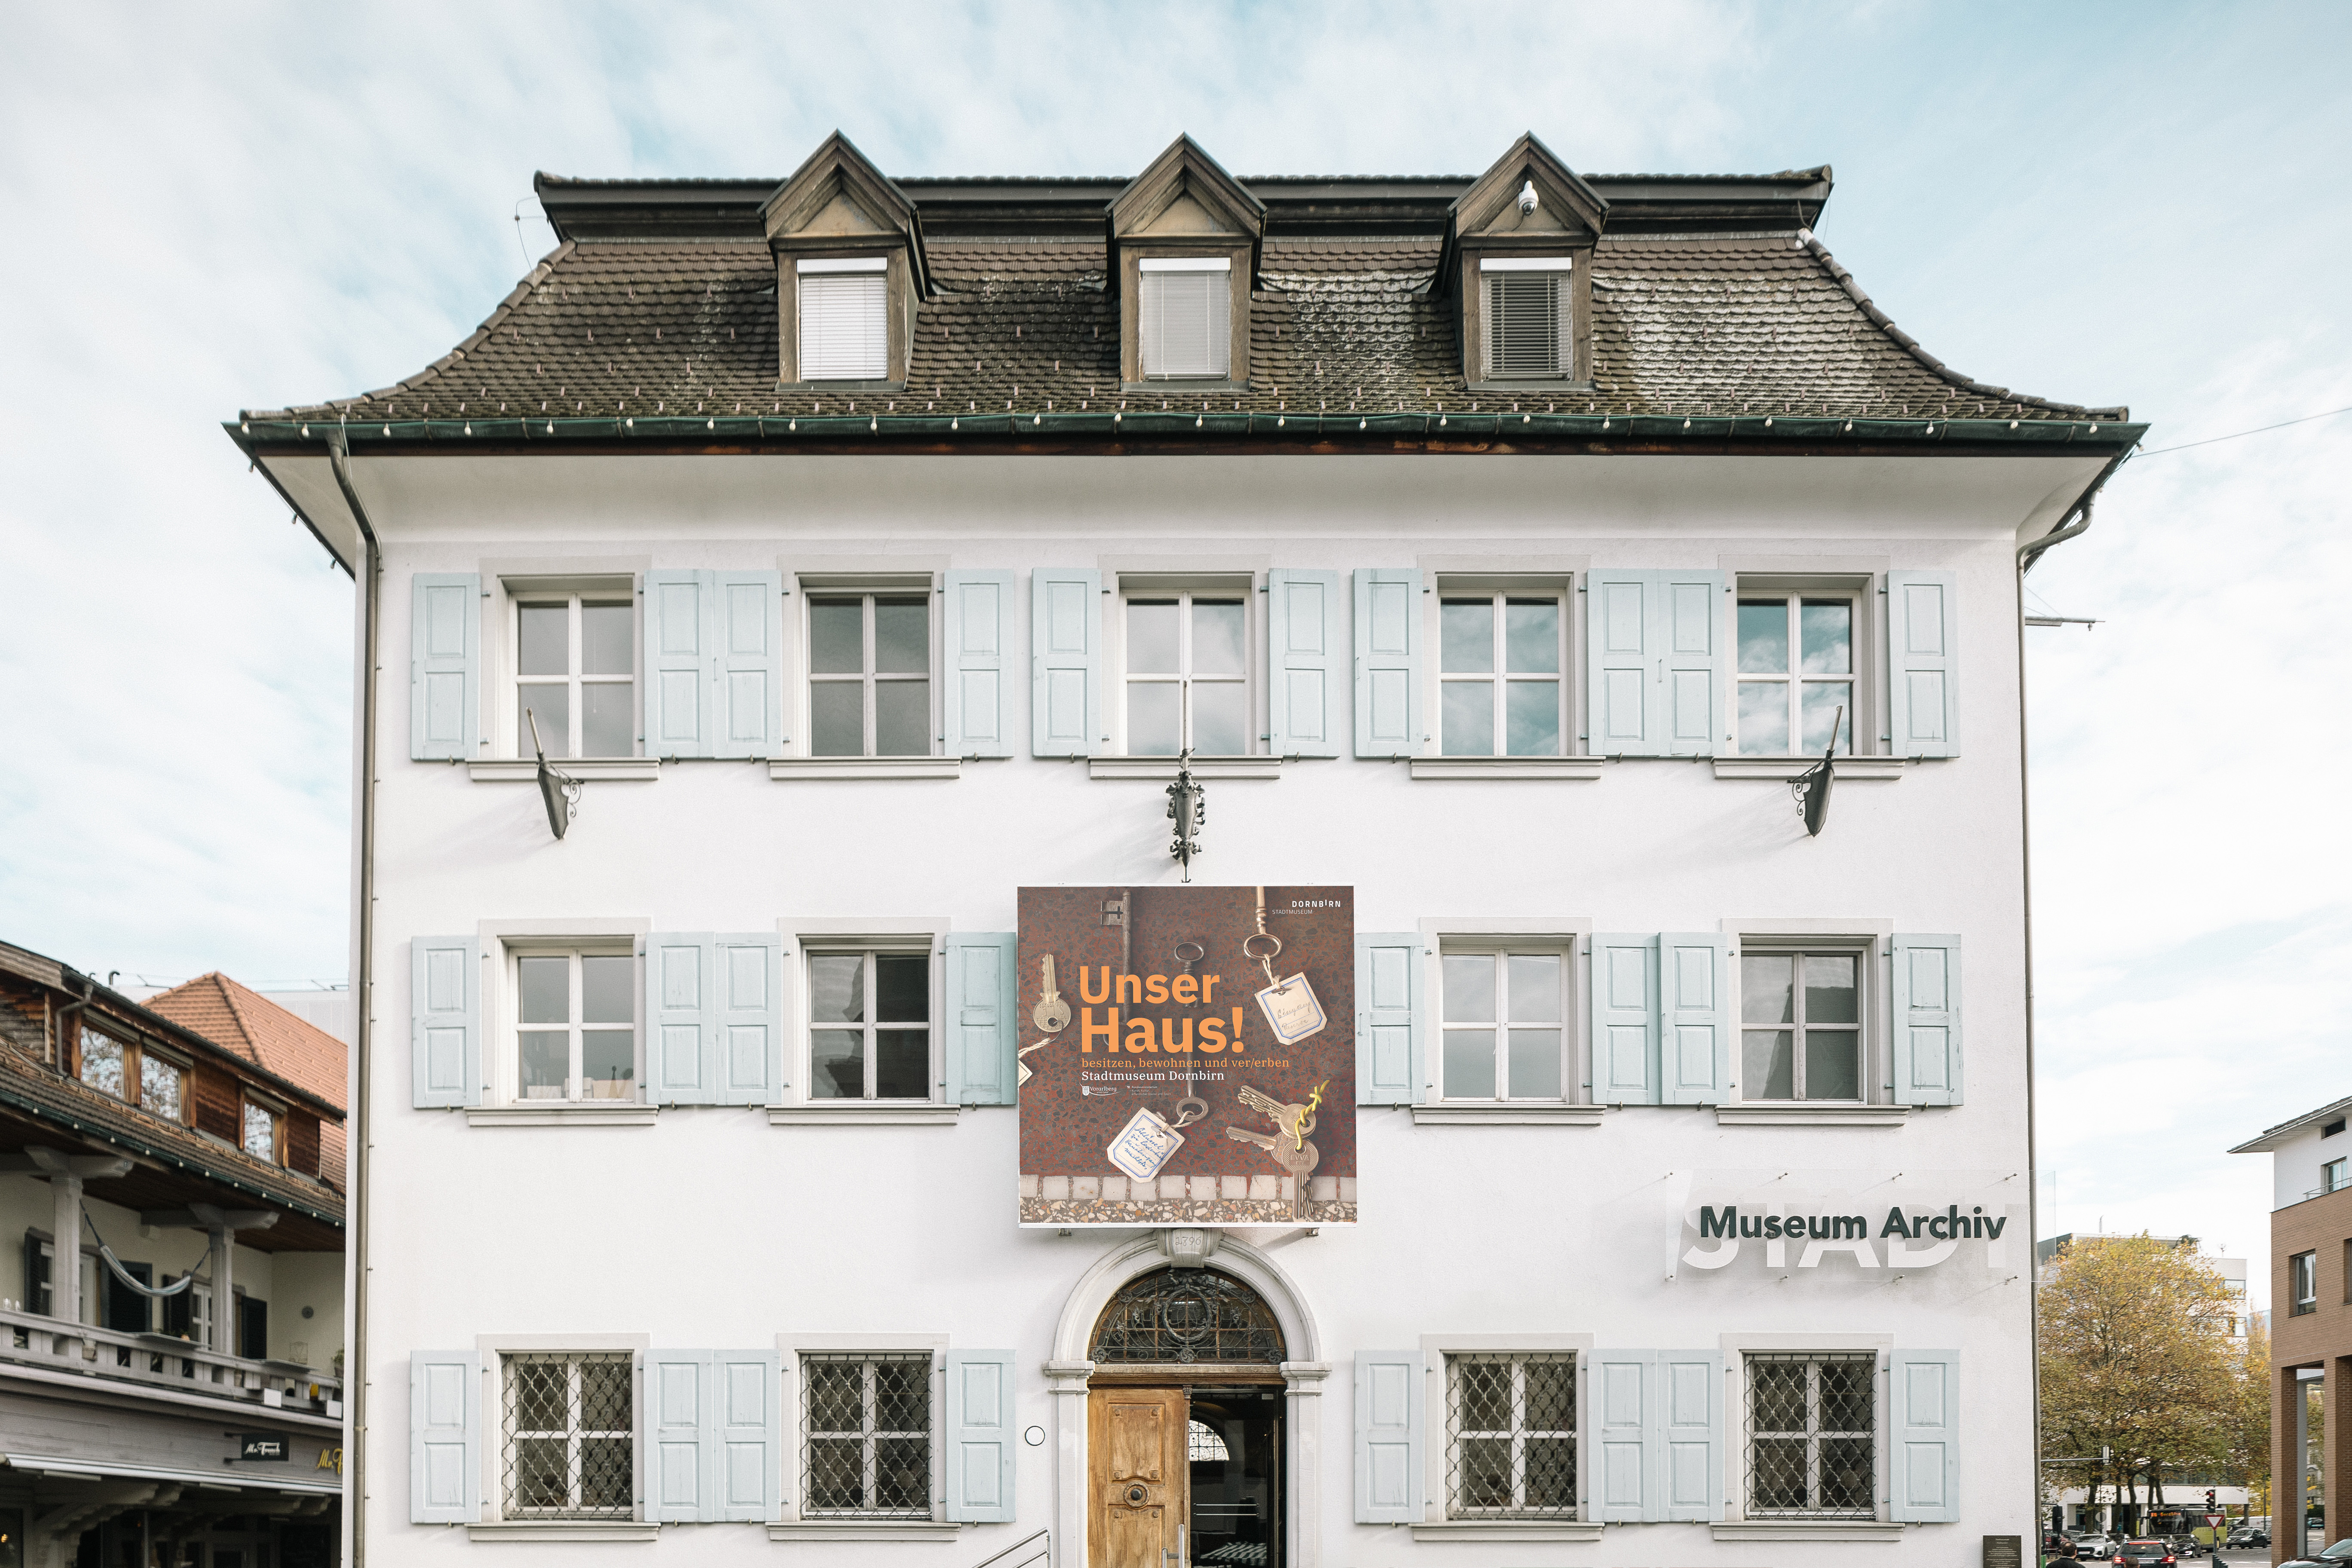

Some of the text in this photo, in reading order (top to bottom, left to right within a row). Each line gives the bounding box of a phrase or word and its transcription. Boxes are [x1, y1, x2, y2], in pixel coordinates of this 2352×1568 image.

[1292, 899, 1341, 907] DORNBIRN
[1080, 966, 1220, 1004] Unser
[1081, 1007, 1244, 1053] Haus!
[1081, 1058, 1289, 1069] besitzen, bewohnen und ver/erben
[1081, 1070, 1225, 1081] Stadtmuseum Dornbirn
[1701, 1204, 2007, 1239] Museum Archiv
